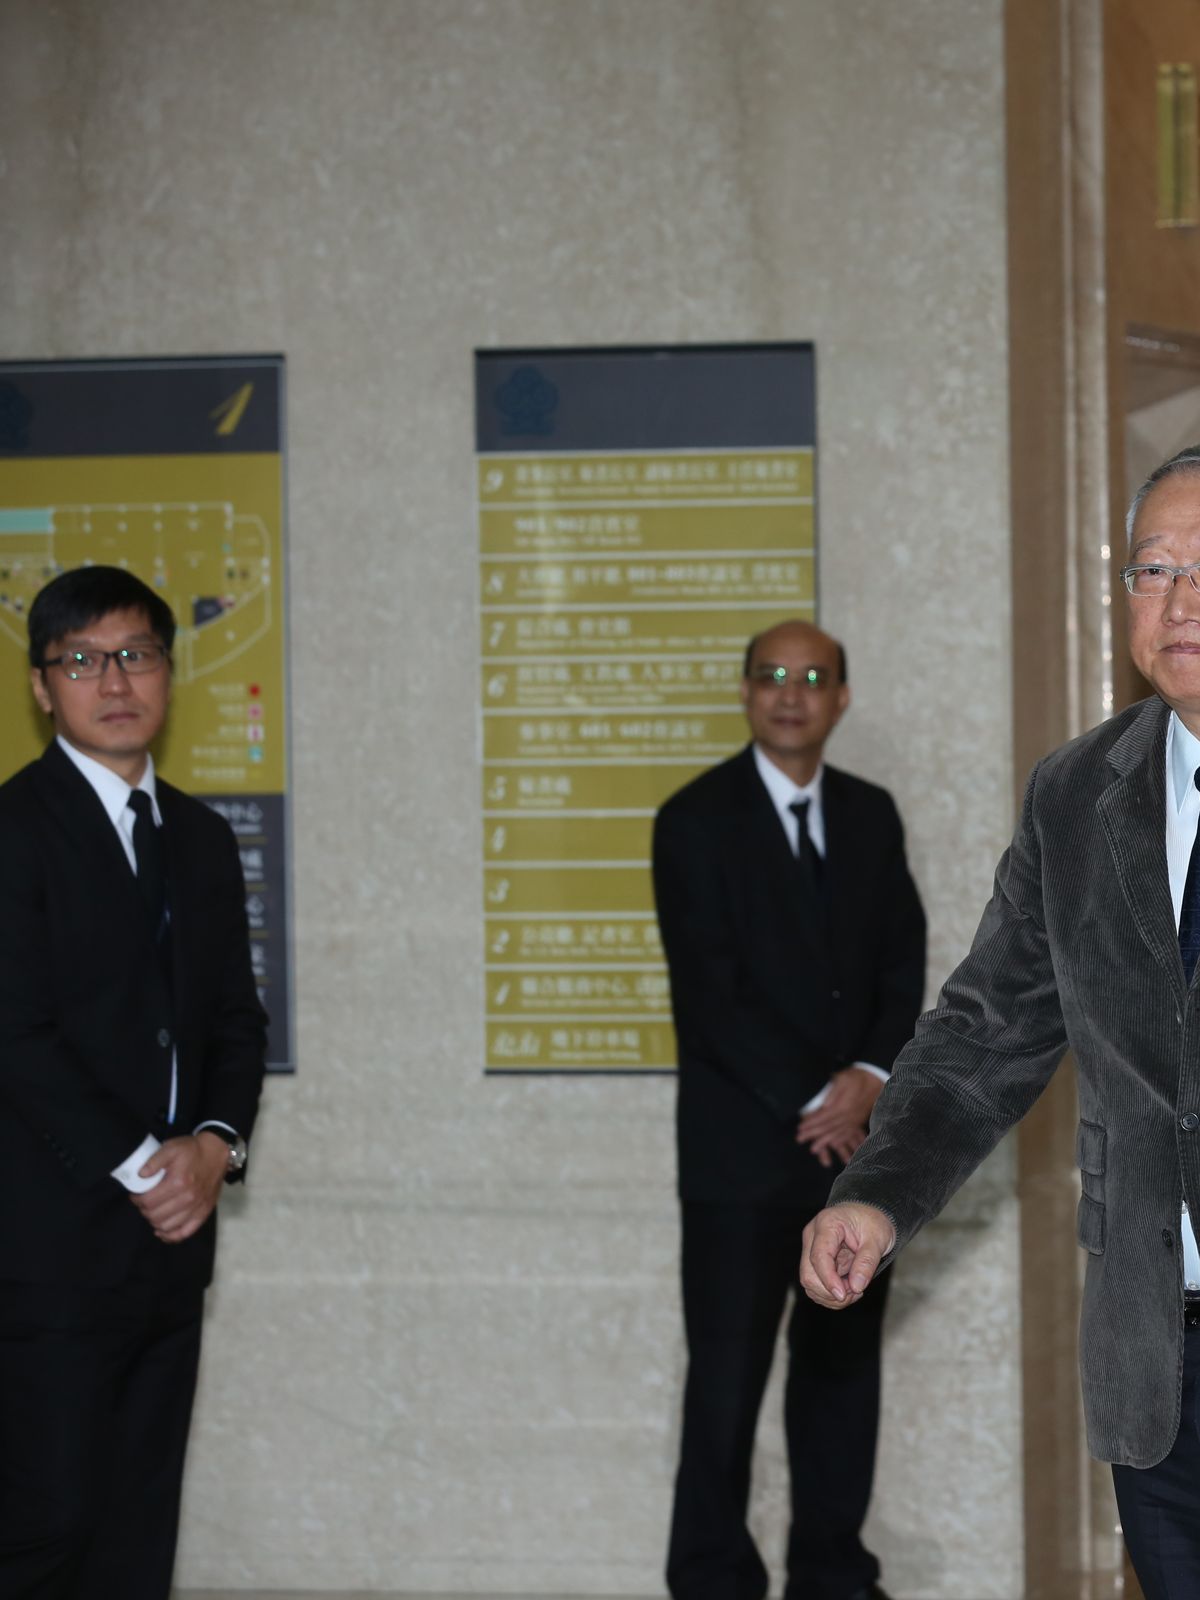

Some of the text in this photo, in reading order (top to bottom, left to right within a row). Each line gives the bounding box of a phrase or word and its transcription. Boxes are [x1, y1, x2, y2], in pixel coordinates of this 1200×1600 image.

[485, 471, 503, 491] 9
[489, 622, 506, 647] 7
[488, 676, 507, 697] 6
[489, 777, 508, 800] 5
[489, 880, 510, 902] 3
[492, 931, 509, 953] 2
[496, 983, 510, 1006] 1
